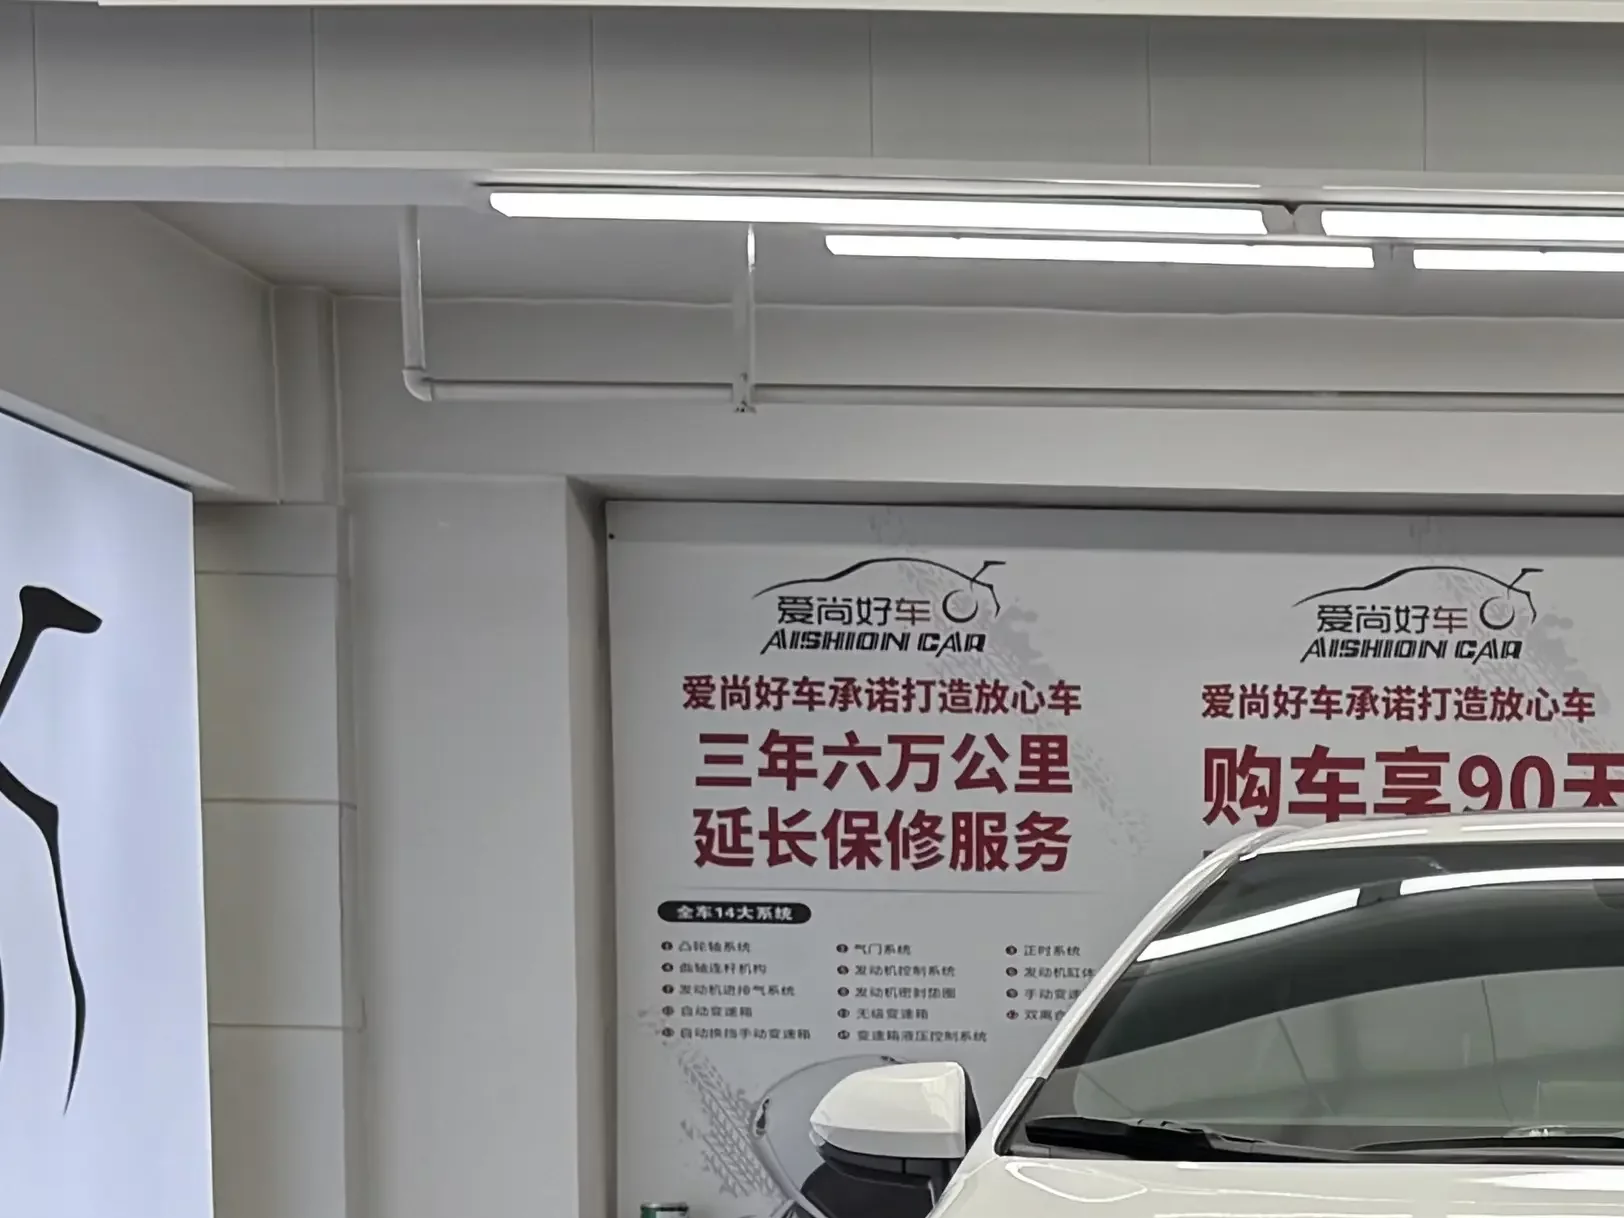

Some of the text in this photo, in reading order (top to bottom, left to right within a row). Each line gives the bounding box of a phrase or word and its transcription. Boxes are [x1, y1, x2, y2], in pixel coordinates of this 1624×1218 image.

[777, 595, 931, 627] 爱尚好车
[1316, 604, 1469, 635] 爱尚好车
[916, 631, 987, 658] CAR
[1454, 637, 1523, 666] CAR
[682, 673, 1082, 717] 爱尚好车承诺打造放心车
[1201, 682, 1596, 724] 爱尚好车承诺打造放心车
[695, 727, 1073, 795] 三年六万公里
[692, 806, 1072, 873] 延长保修服务
[676, 904, 793, 921] 全车14大系统
